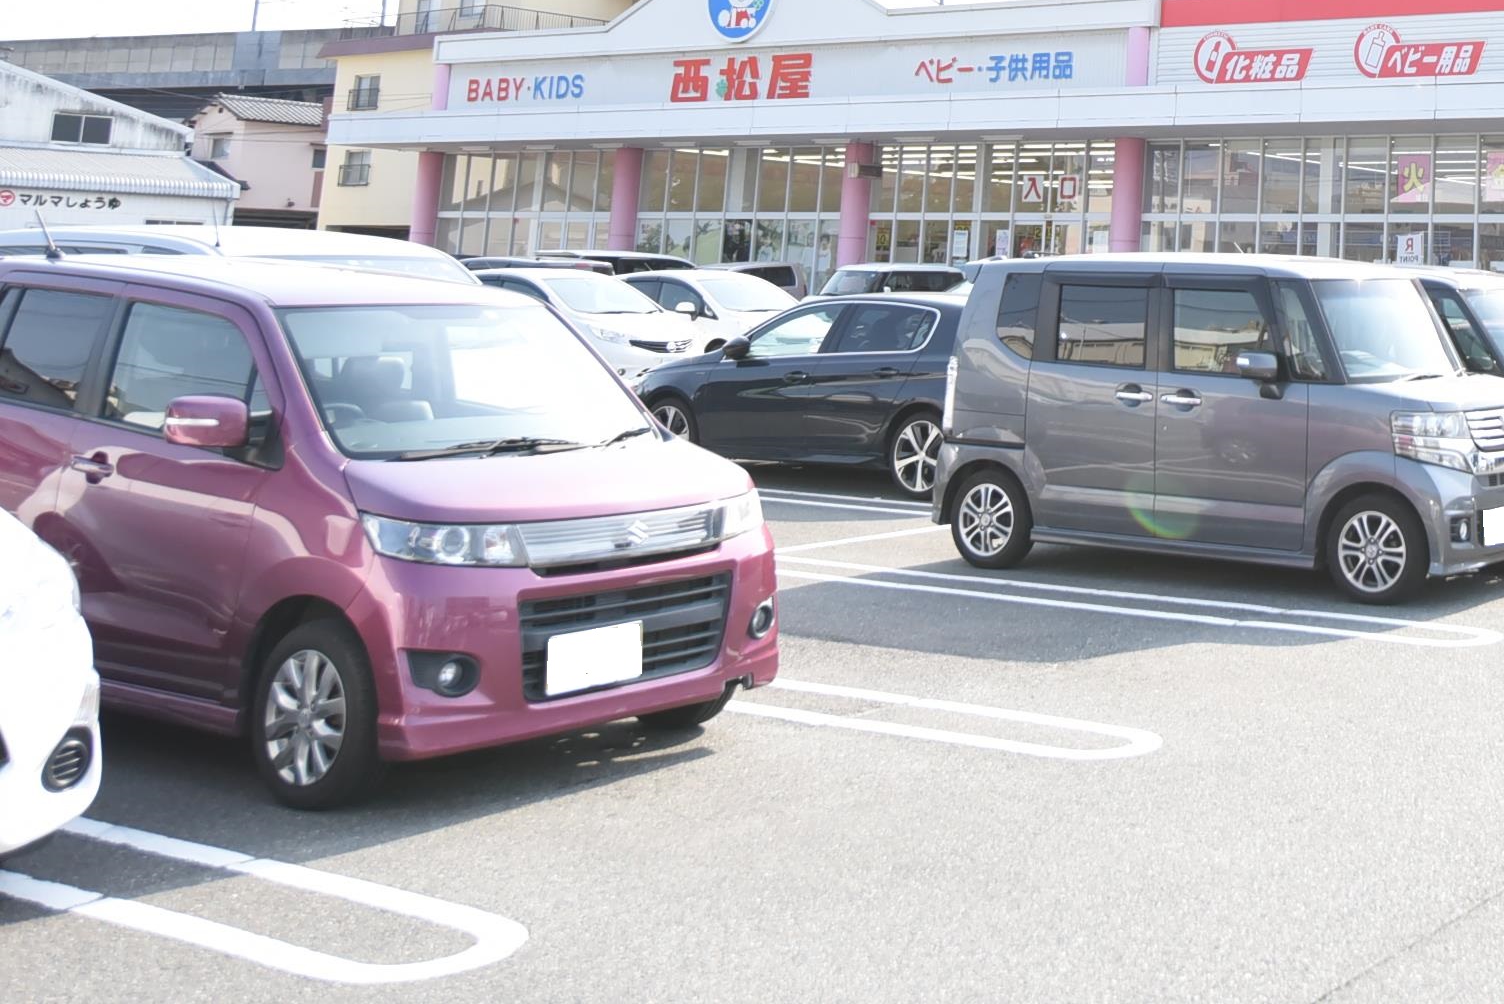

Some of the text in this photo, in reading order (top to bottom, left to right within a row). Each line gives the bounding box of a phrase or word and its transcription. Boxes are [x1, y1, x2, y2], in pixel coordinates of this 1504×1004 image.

[1224, 53, 1301, 80] 化粧品
[1387, 45, 1474, 73] ベビー用品
[669, 52, 813, 103] 西松屋
[1403, 162, 1424, 193] 火
[20, 194, 122, 209] マルマしょうゆ
